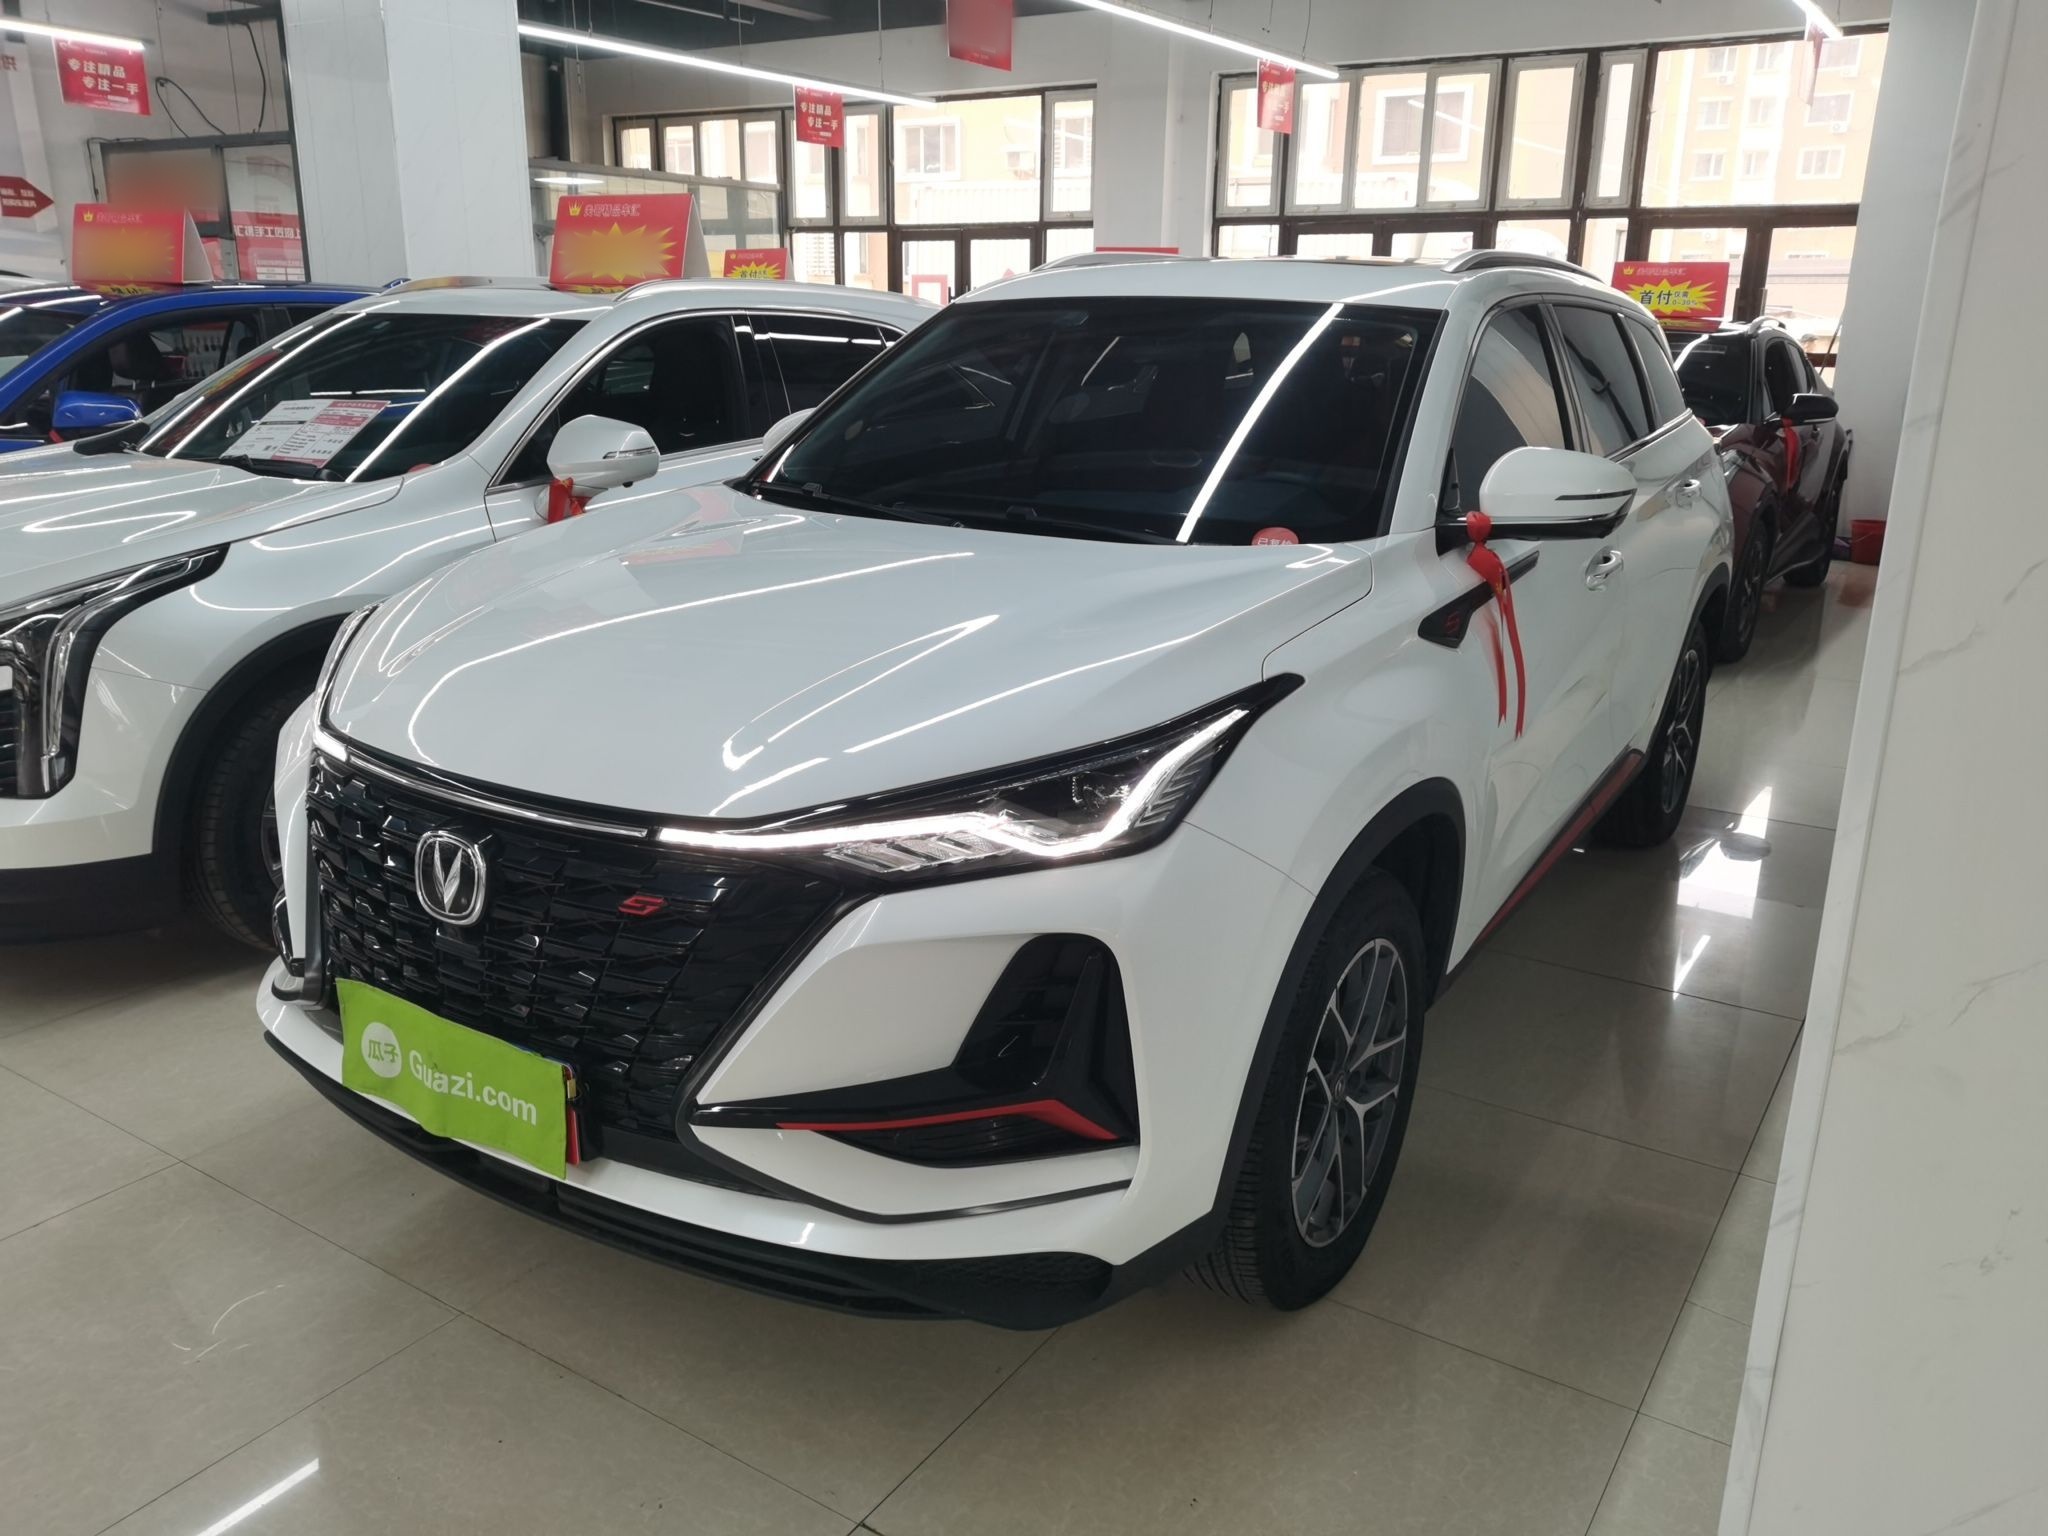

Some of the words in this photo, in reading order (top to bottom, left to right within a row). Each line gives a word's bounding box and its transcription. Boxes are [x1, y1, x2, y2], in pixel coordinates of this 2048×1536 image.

[82, 76, 139, 95] 专注一手
[1640, 289, 1673, 305] 首付
[367, 1038, 399, 1064] 瓜子
[408, 1050, 538, 1126] Guazi.com
